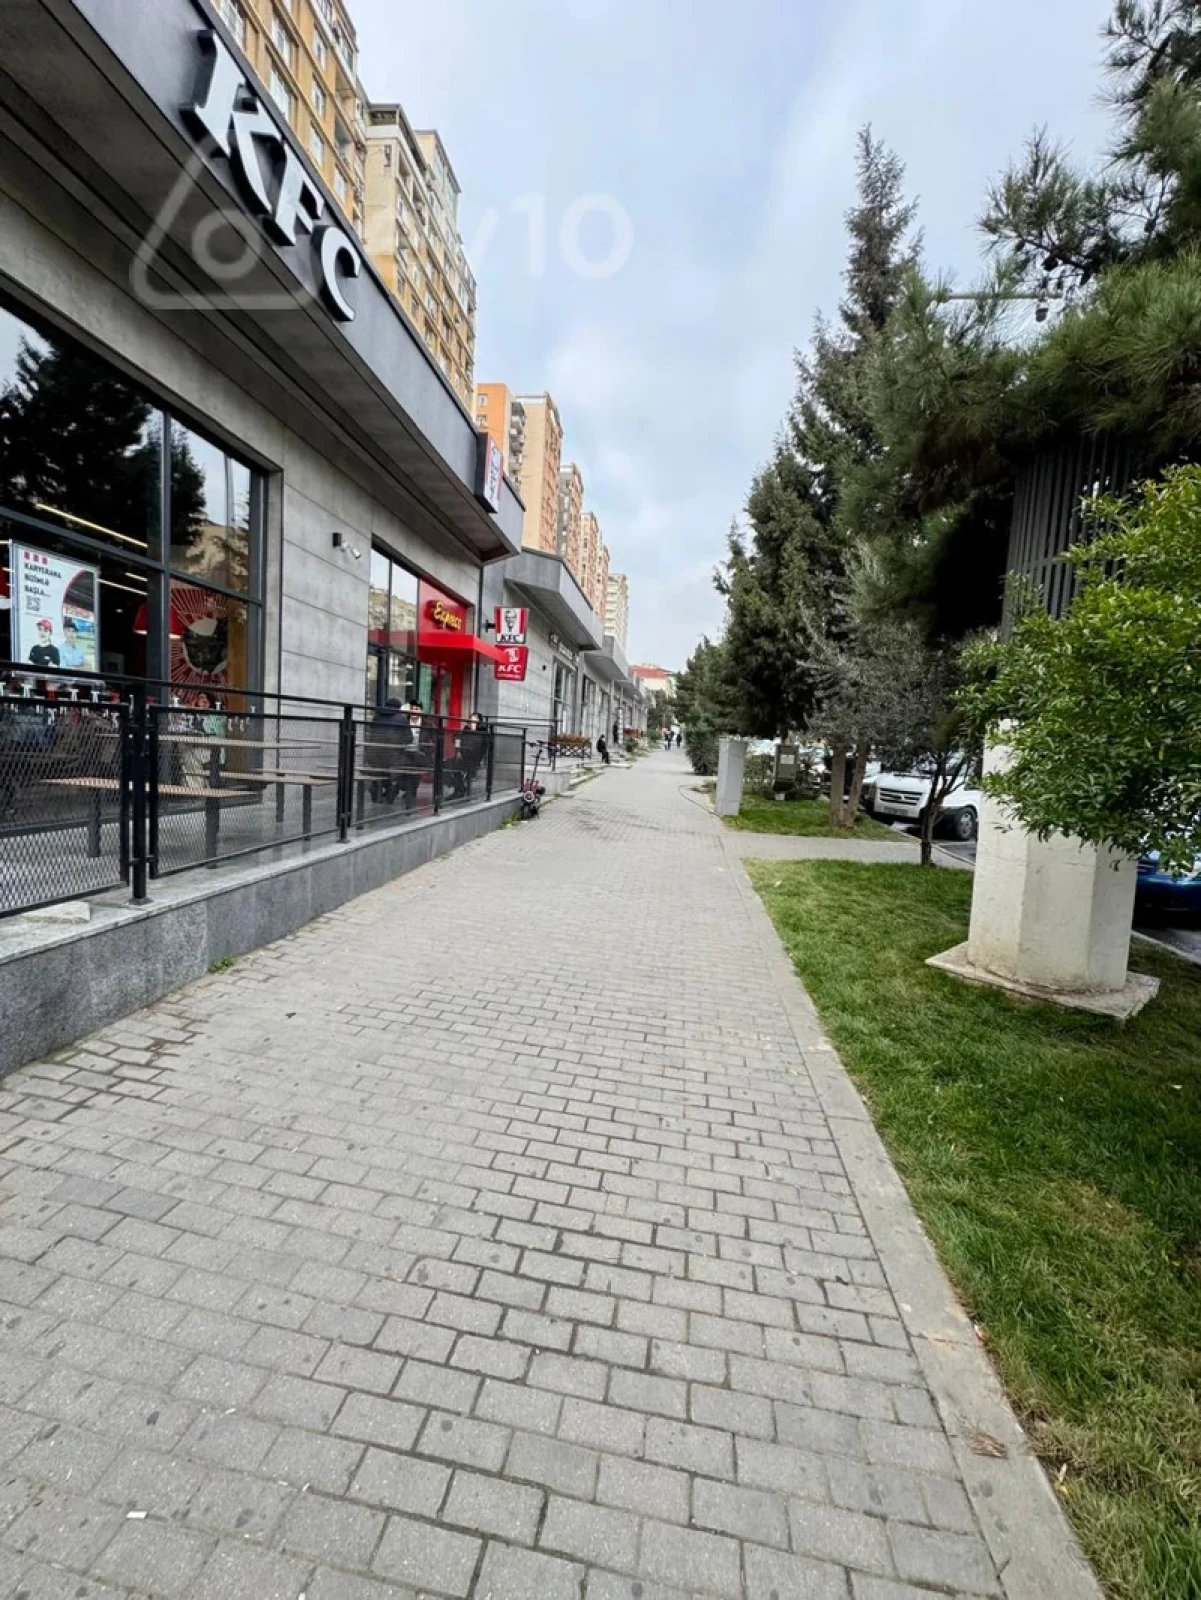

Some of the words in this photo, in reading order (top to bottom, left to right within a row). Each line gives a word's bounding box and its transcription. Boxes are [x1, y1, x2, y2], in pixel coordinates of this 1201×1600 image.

[180, 28, 360, 322] KFC
[499, 634, 521, 643] KFC
[497, 664, 521, 674] KFC
